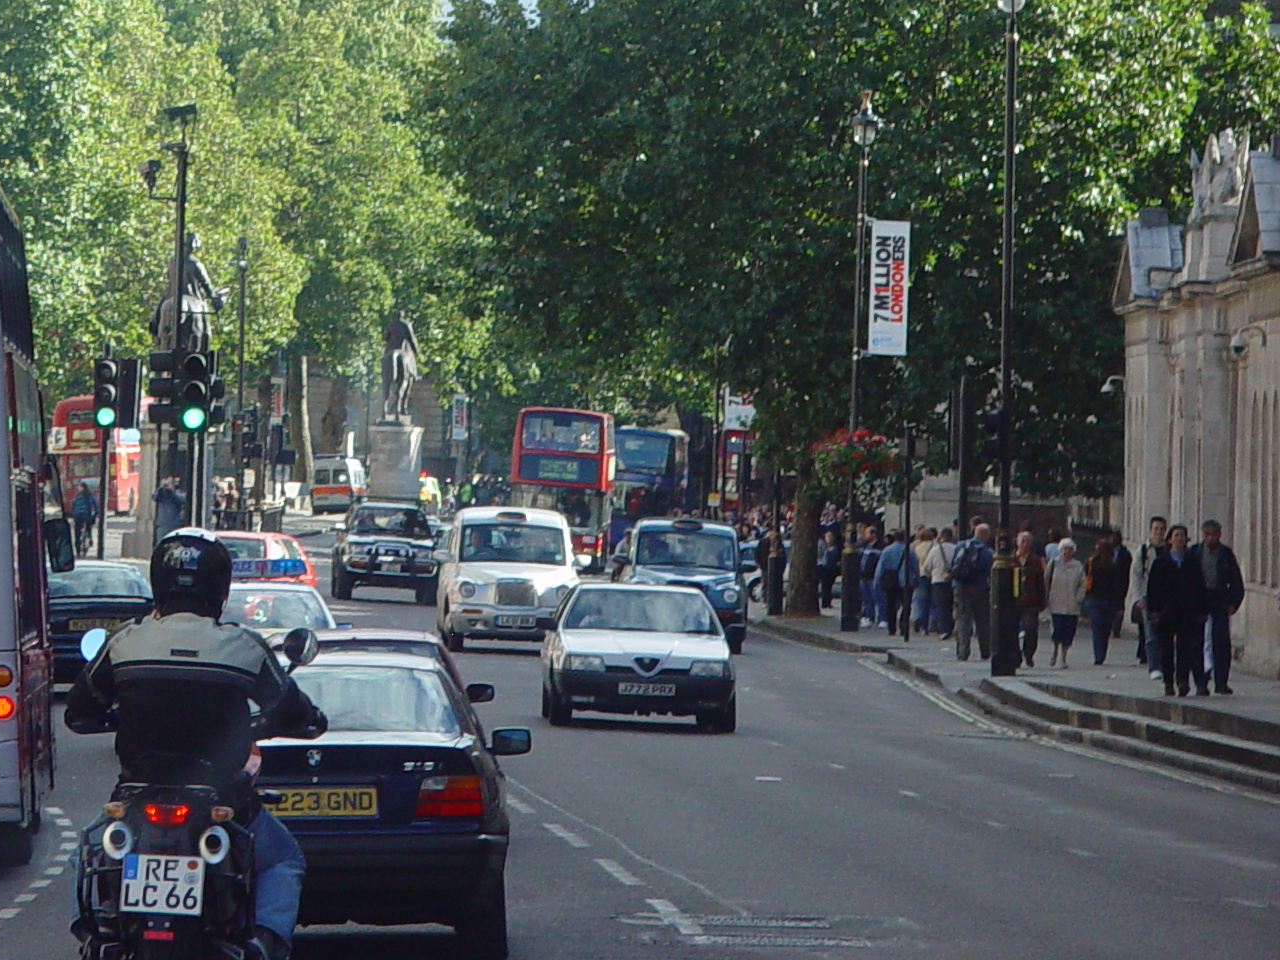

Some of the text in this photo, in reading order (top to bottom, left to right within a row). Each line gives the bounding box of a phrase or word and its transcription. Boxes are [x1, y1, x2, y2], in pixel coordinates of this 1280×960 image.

[889, 235, 905, 323] LONDONERS
[873, 312, 890, 324] 7
[269, 791, 373, 813] 223 GND
[145, 858, 180, 882] RE
[123, 883, 198, 910] LC 66
